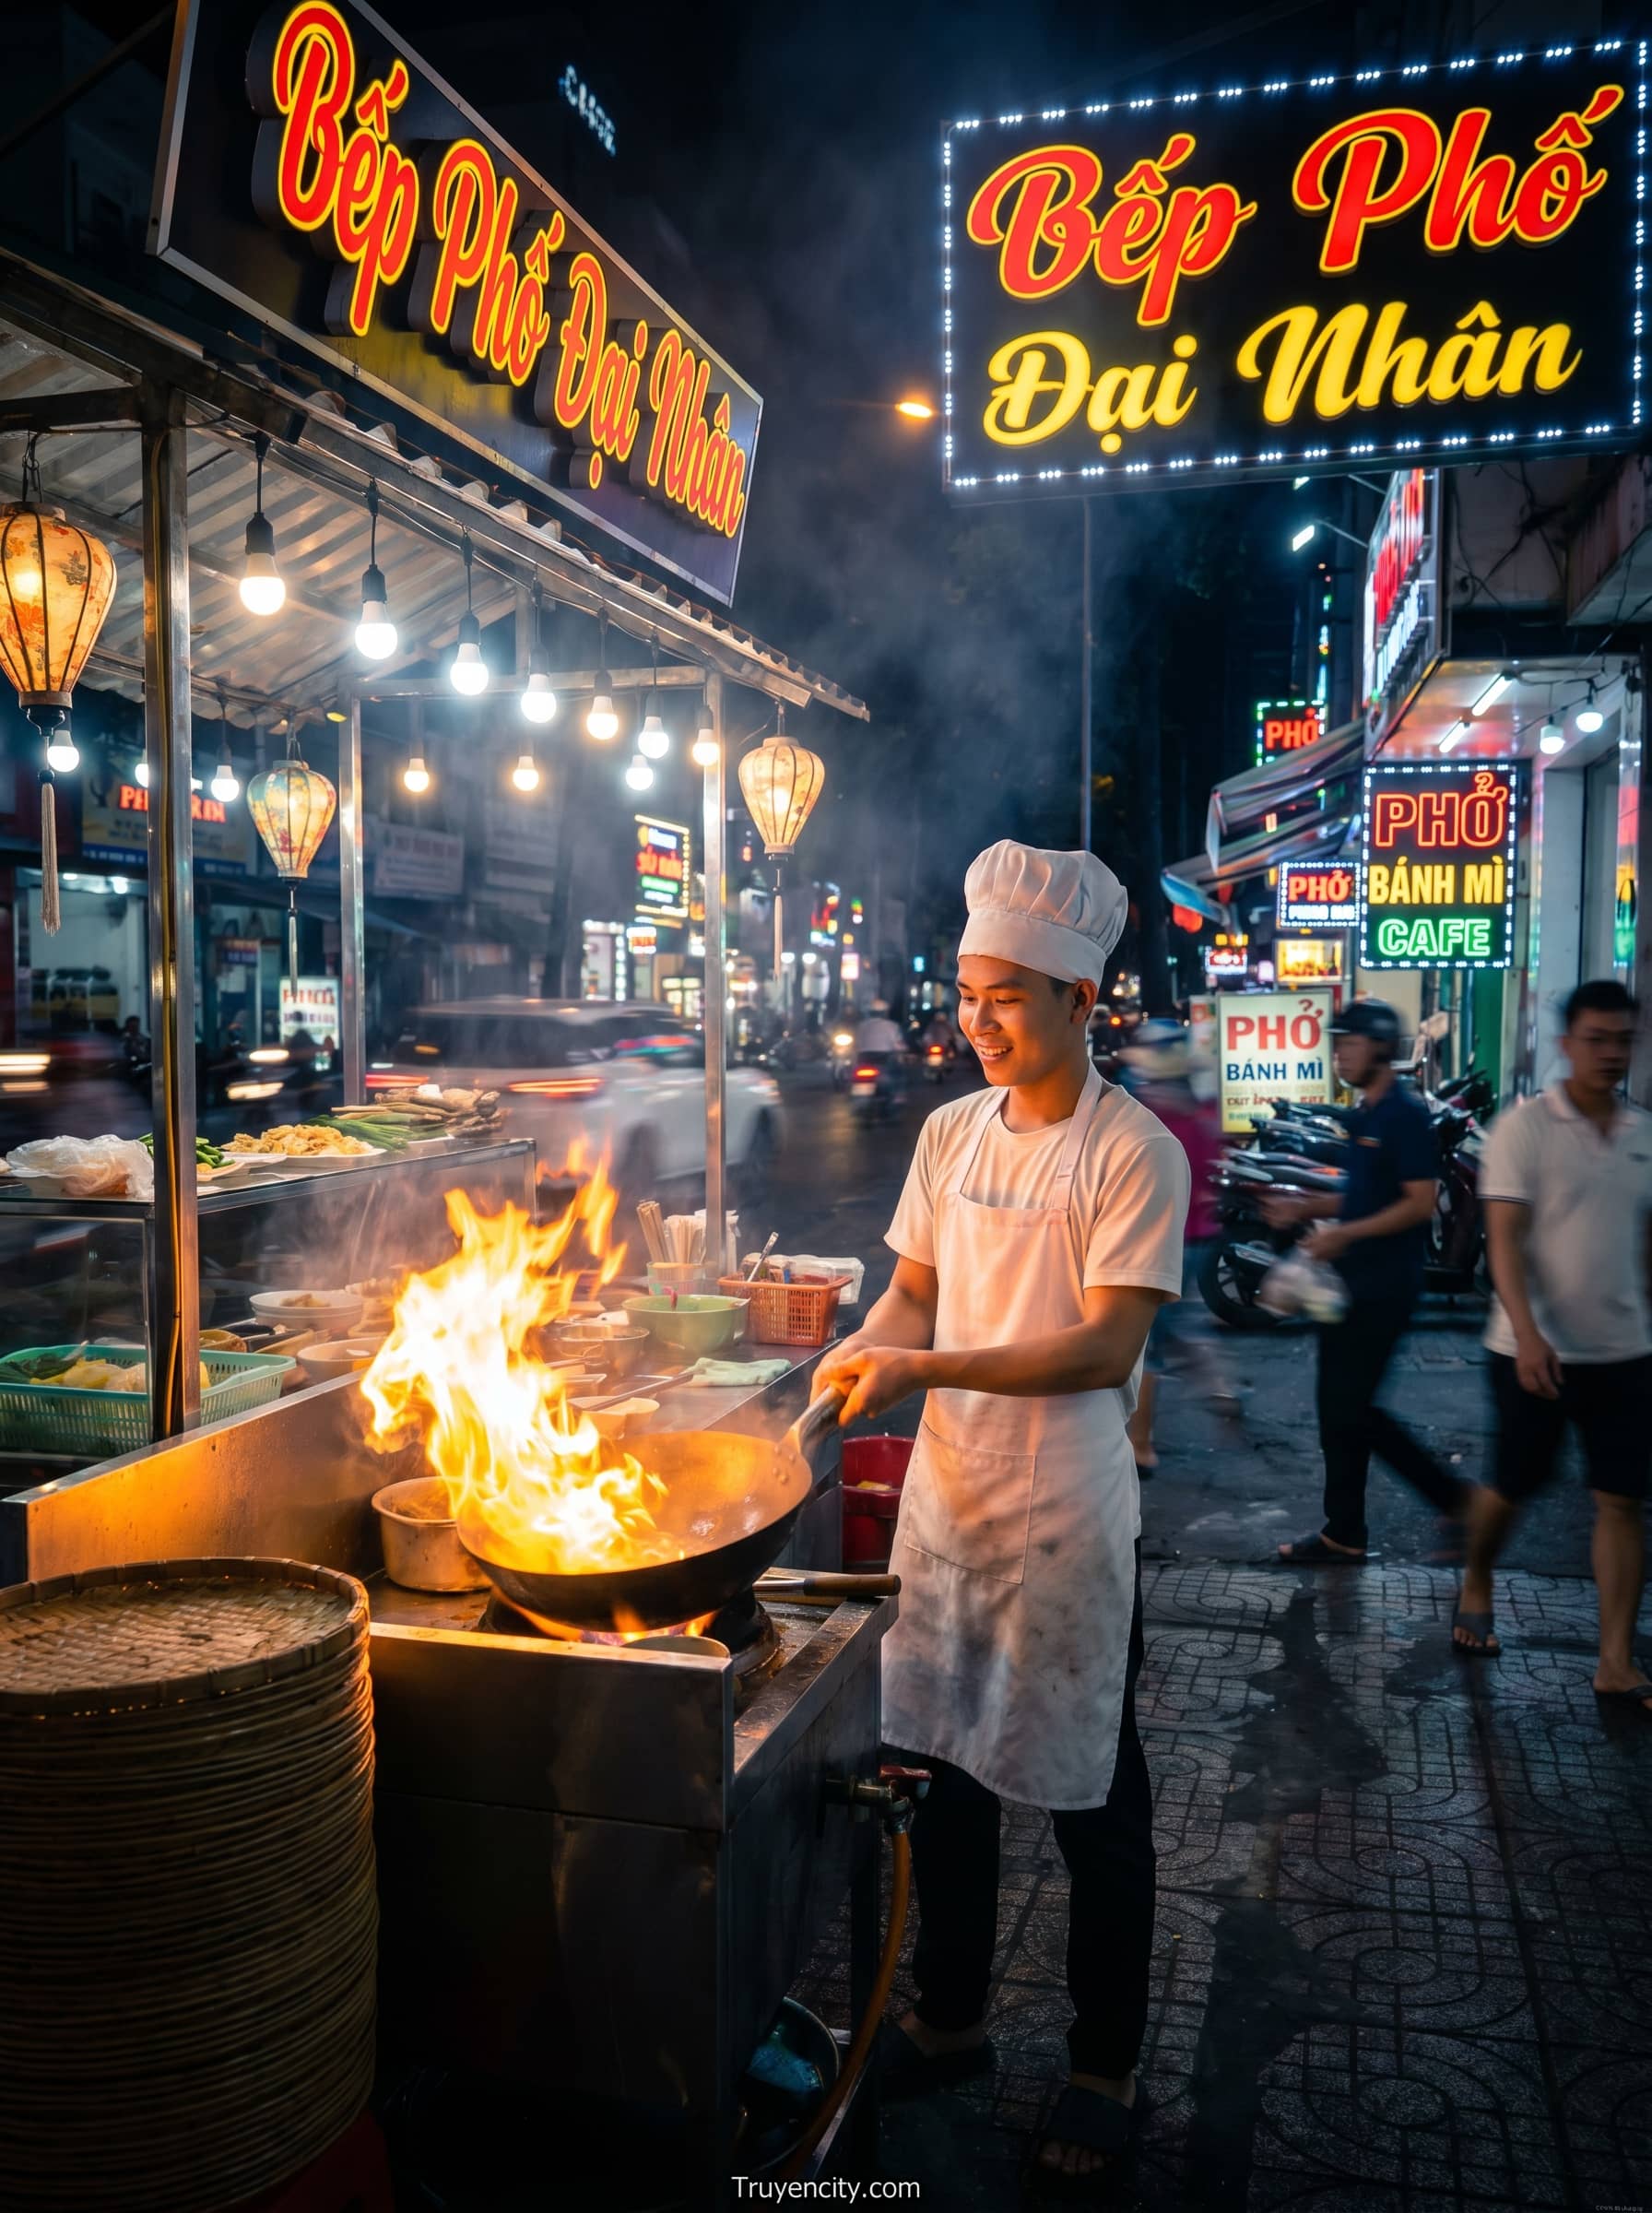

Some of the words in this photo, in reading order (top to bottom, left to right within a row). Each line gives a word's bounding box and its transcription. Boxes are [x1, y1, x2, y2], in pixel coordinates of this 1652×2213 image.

[967, 133, 1257, 327] Bếp
[1292, 84, 1624, 275] Phố
[273, 0, 419, 337] Bếp
[430, 138, 564, 386] Phố
[554, 252, 648, 490] Đại
[647, 328, 746, 538] Nhân
[983, 332, 1198, 455] Đại
[1237, 300, 1584, 426] Nhân
[1375, 772, 1508, 847] PHỞ
[1288, 869, 1352, 903] PHỞ
[1368, 855, 1455, 905] BÁNH
[1463, 855, 1504, 905] MÌ
[1378, 918, 1491, 957] CAFE
[1226, 999, 1324, 1050] PHỞ
[1226, 1058, 1287, 1082] BÁNH
[1297, 1057, 1323, 1081] MÌ
